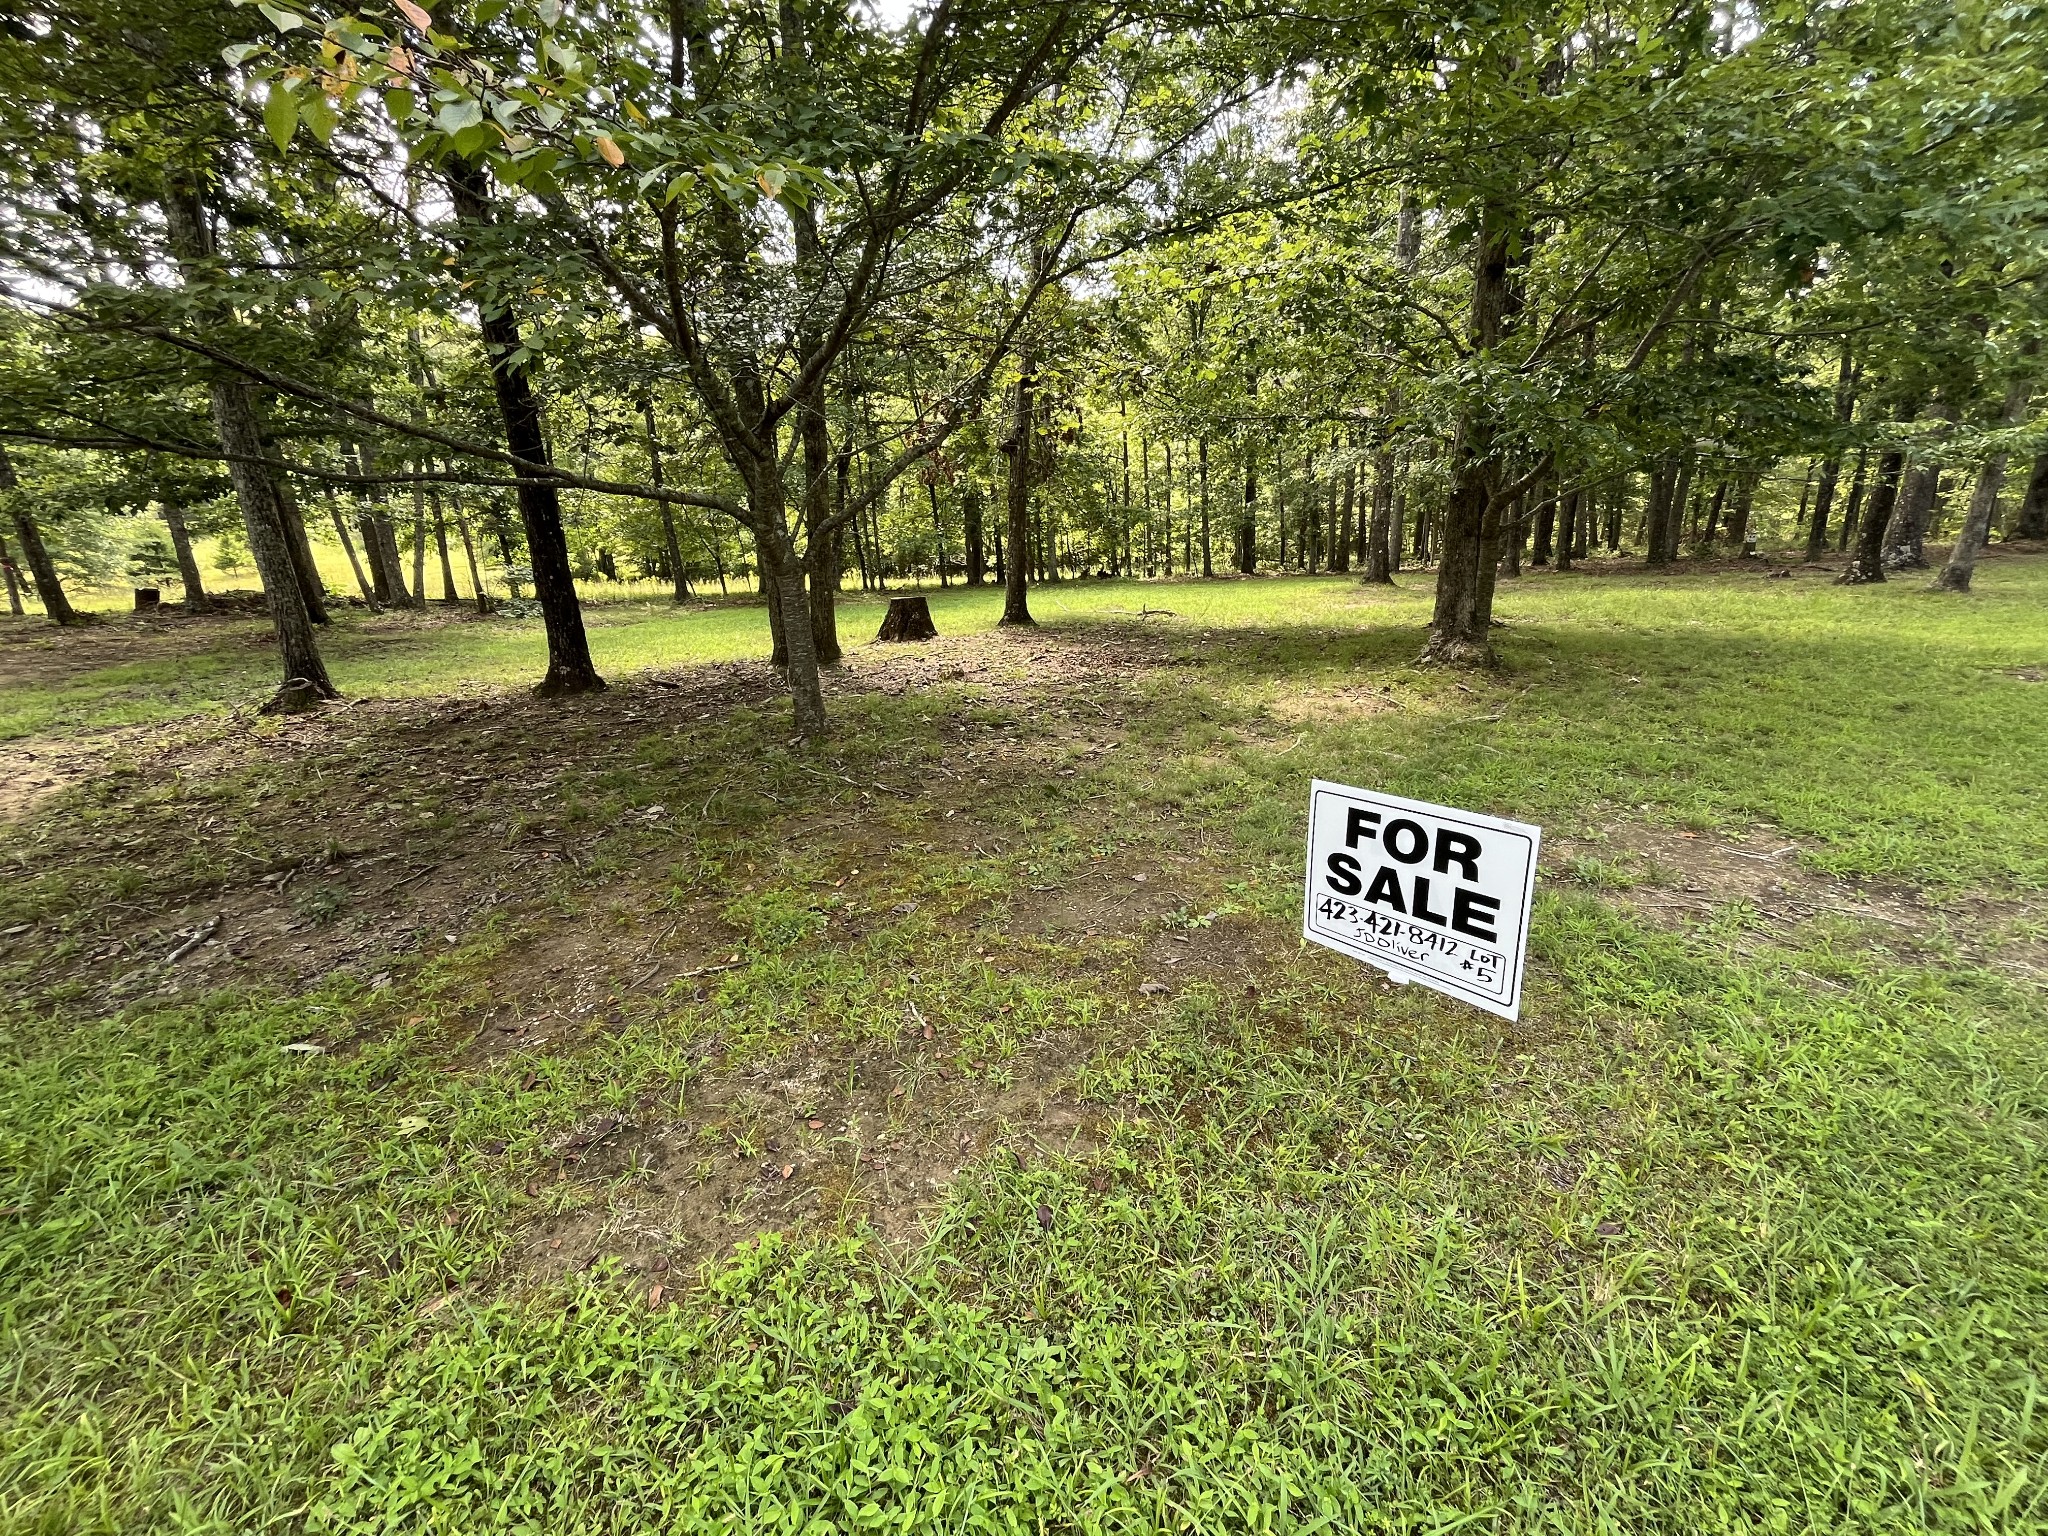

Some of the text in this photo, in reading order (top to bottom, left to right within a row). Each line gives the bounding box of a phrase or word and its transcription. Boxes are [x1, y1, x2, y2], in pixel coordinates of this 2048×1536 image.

[1345, 807, 1482, 882] FOR
[1318, 898, 1458, 957] 423-421-8412
[1326, 852, 1501, 943] SALE
